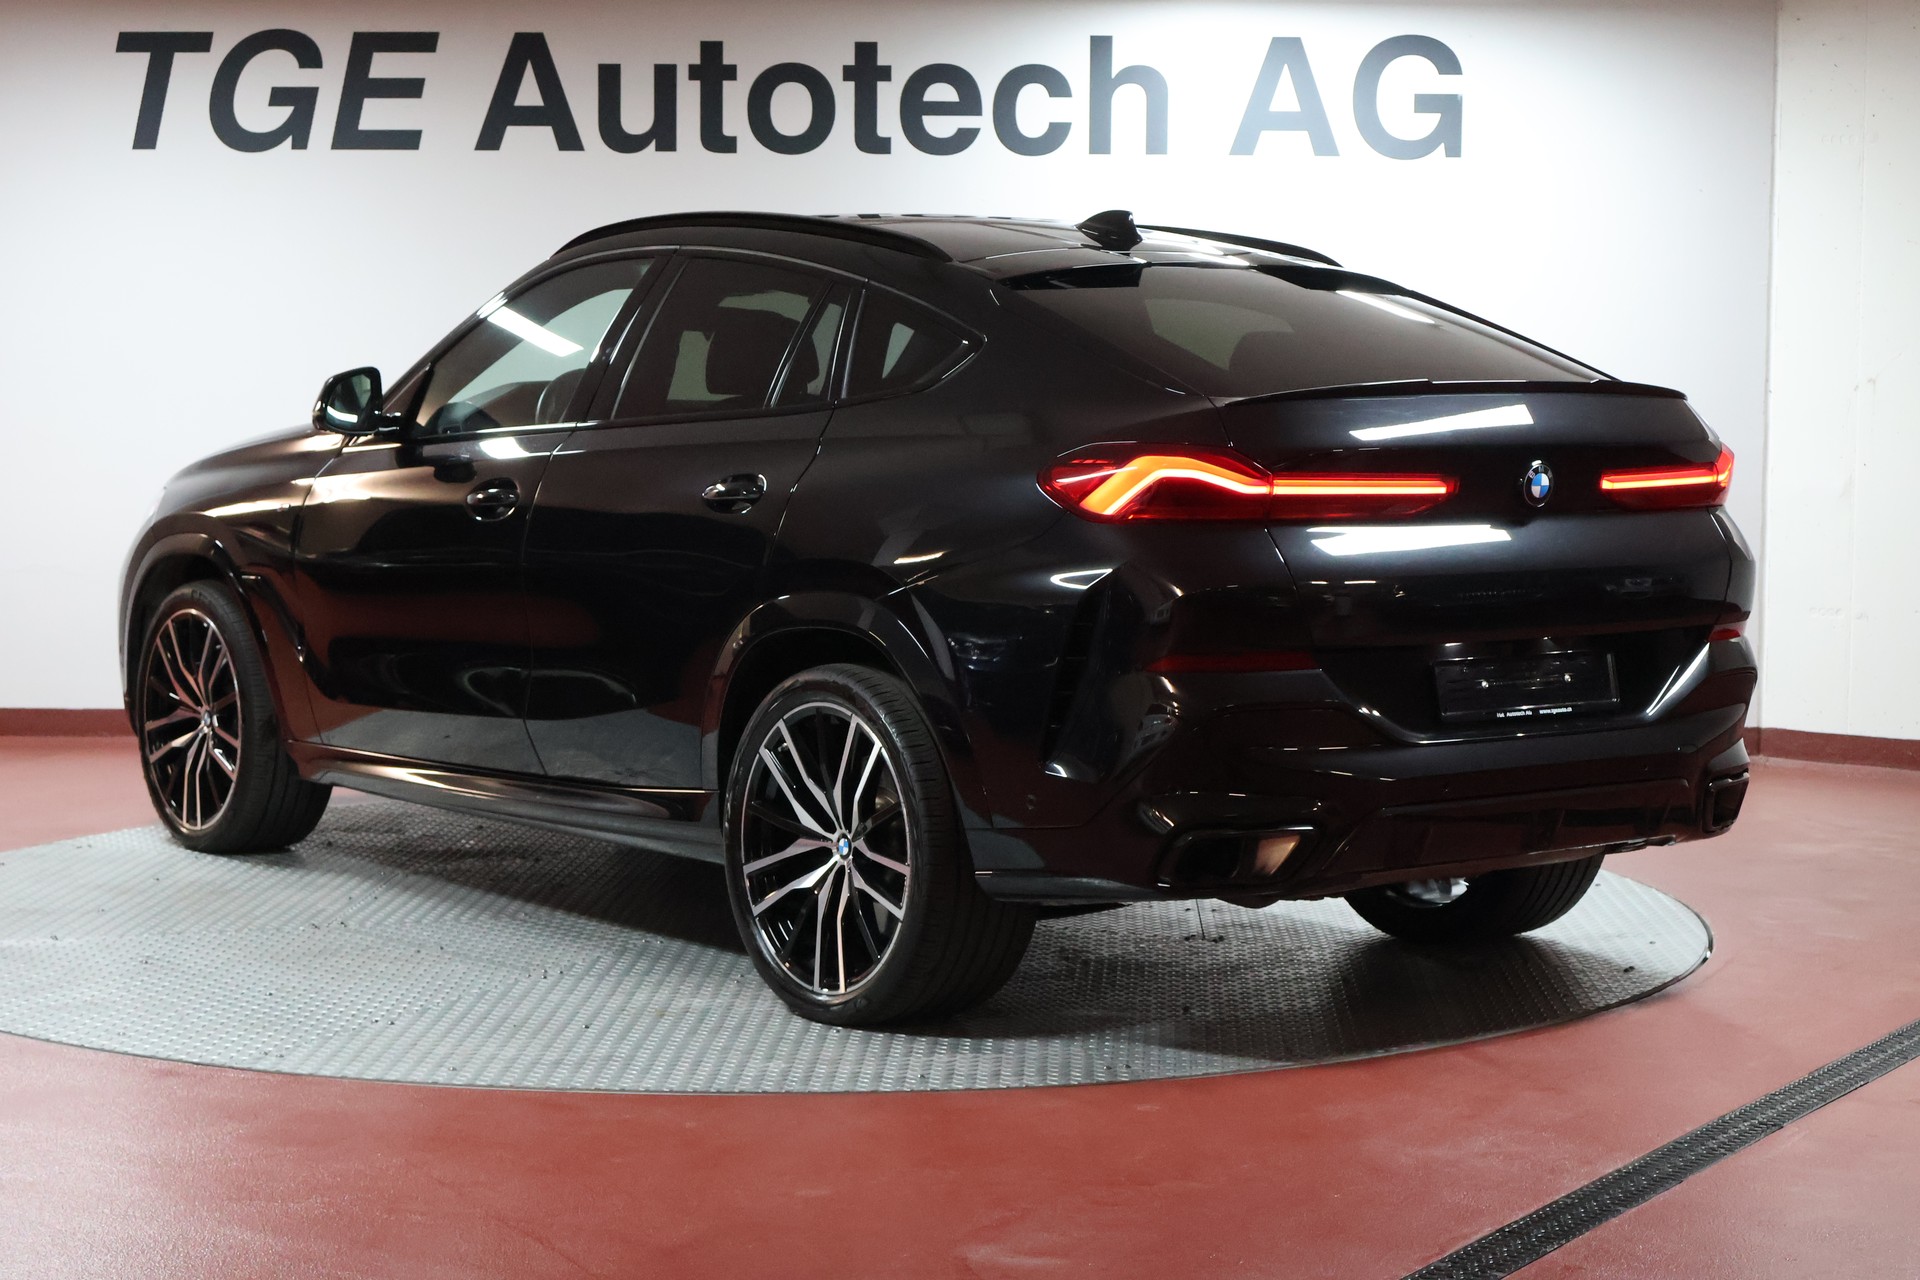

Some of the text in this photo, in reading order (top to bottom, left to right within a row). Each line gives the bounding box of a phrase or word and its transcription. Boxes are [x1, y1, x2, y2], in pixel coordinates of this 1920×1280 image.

[115, 29, 1463, 160] TGE Autotech AG
